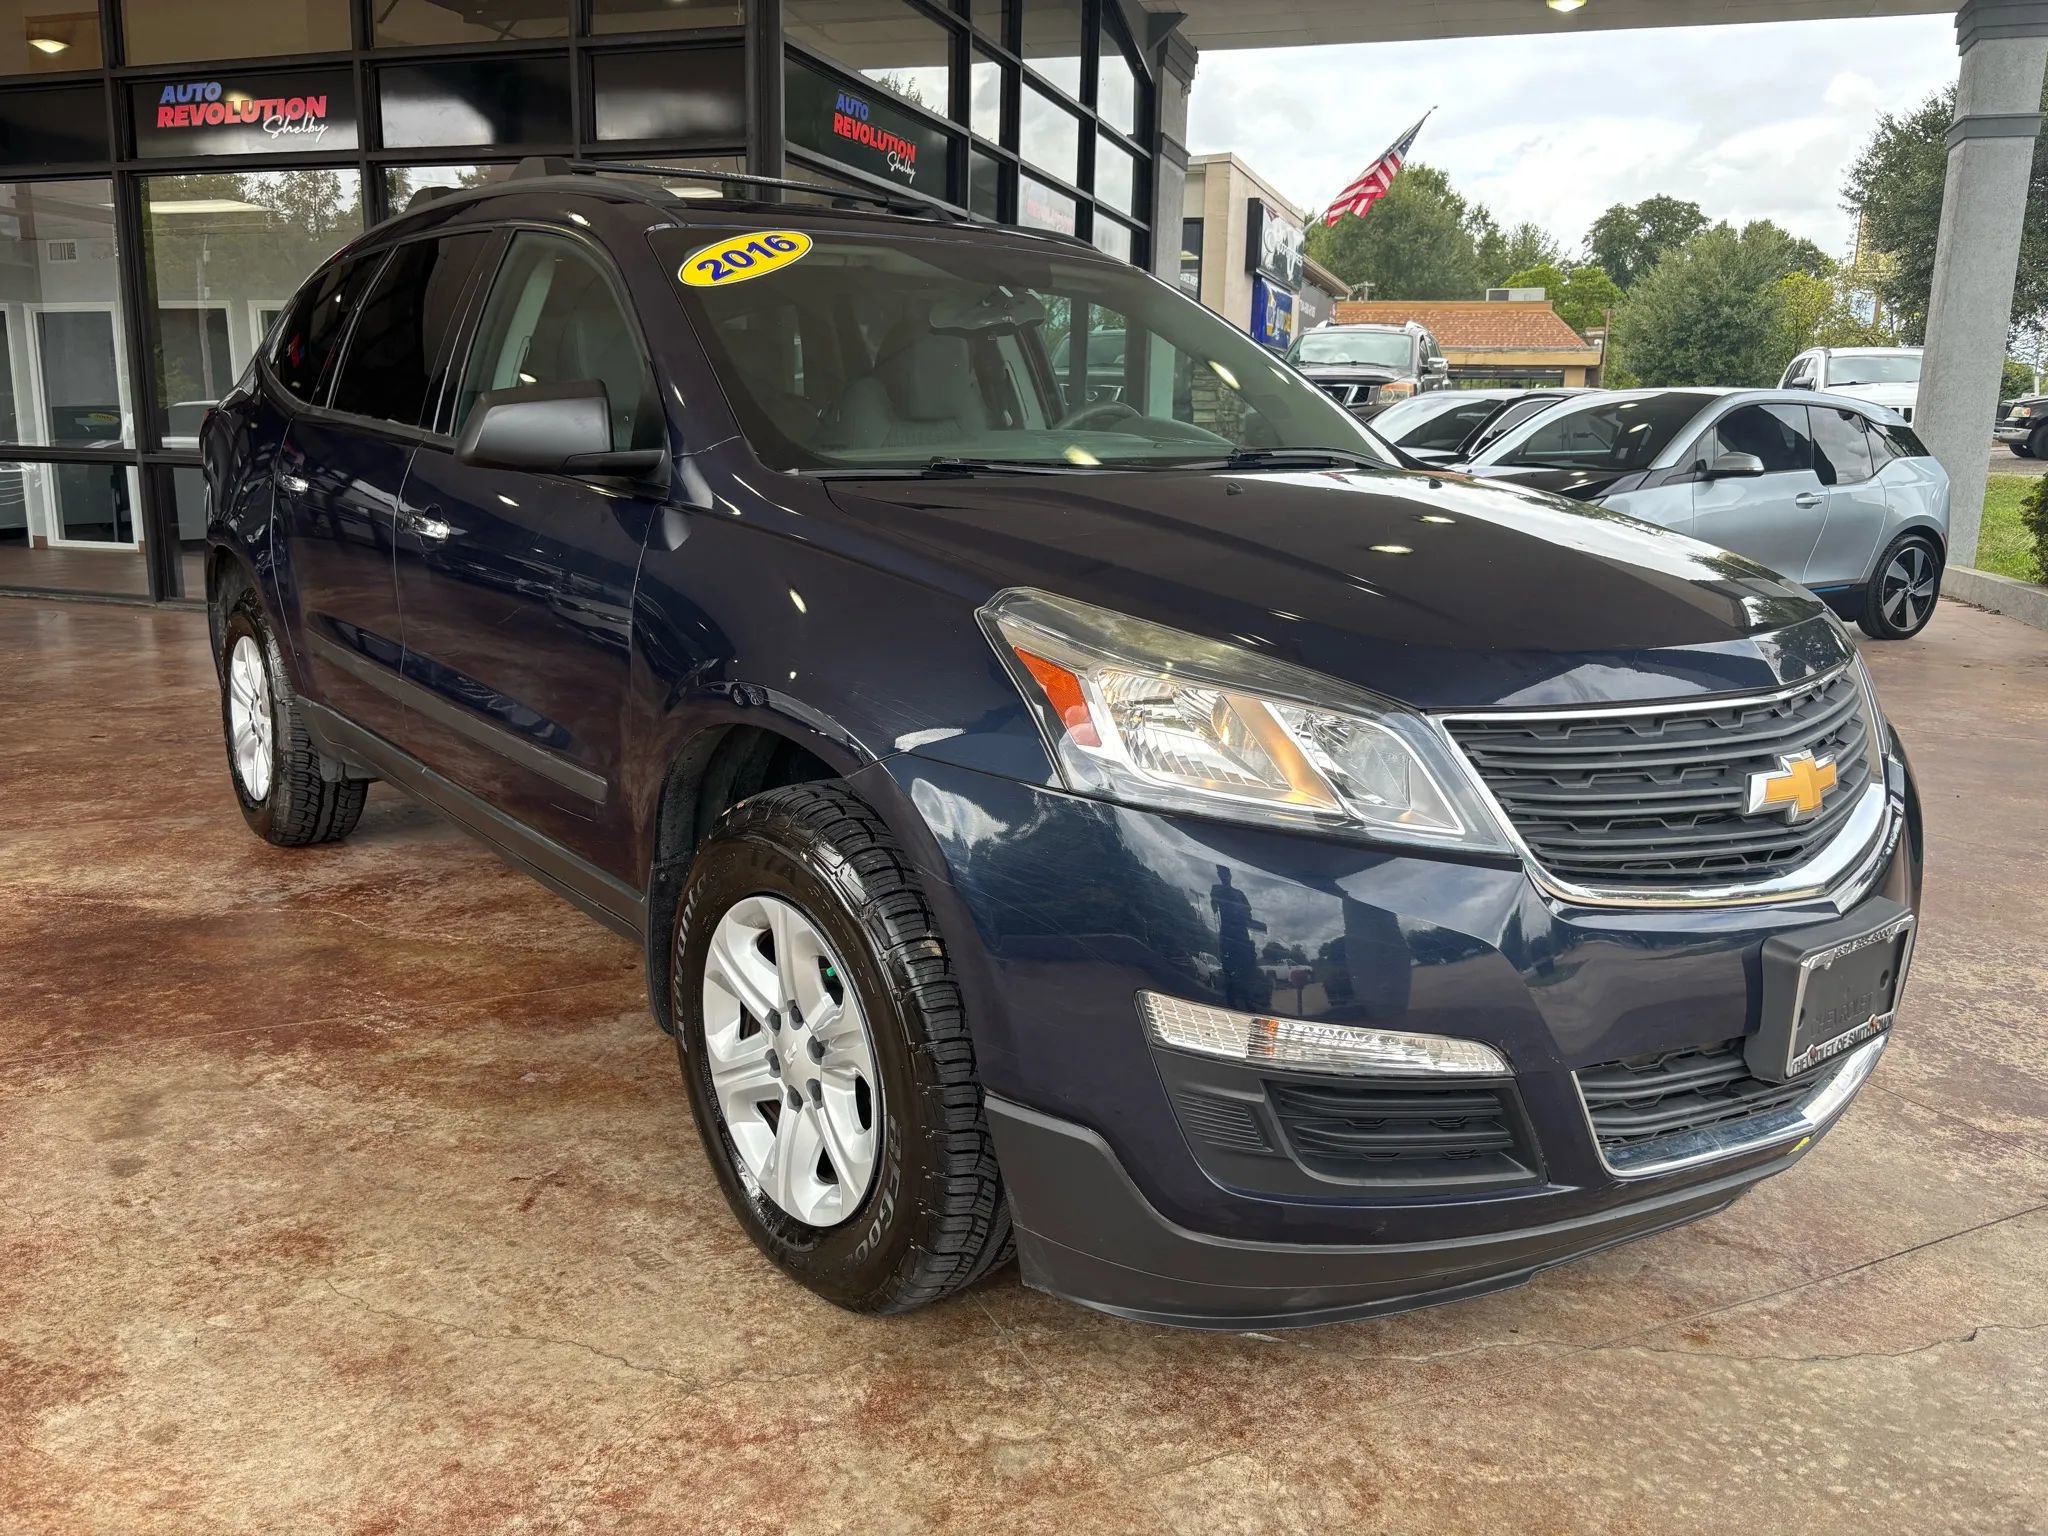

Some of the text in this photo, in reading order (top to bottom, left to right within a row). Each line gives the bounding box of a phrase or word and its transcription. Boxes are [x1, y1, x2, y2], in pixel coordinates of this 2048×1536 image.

[160, 82, 222, 104] AUTO
[835, 93, 868, 121] AUTO
[157, 96, 328, 128] REVOLUTION
[263, 112, 328, 142] Shelby
[833, 112, 915, 163] REVOLUTION
[886, 150, 916, 184] Shelby
[697, 235, 798, 281] 2016
